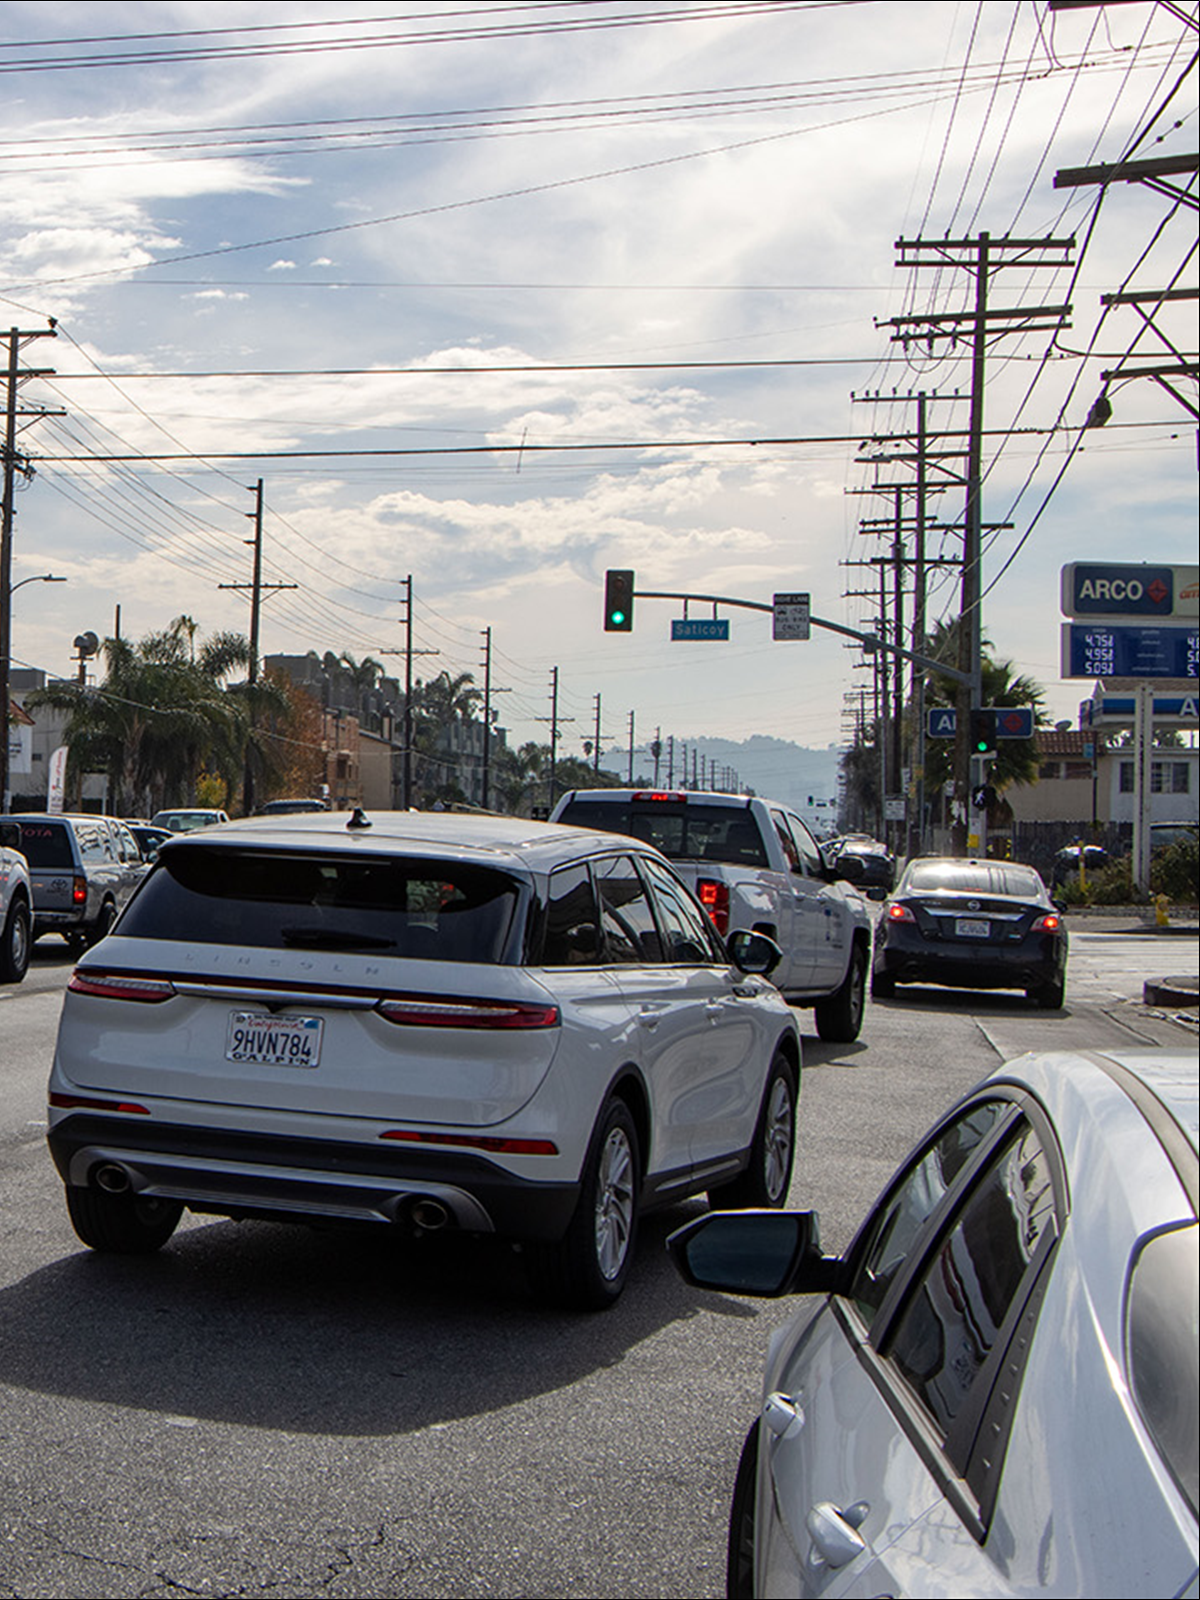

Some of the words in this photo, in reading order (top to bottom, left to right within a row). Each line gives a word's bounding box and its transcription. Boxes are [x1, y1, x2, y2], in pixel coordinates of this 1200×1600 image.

[1078, 579, 1144, 601] ARCO
[674, 623, 726, 637] Saticoy
[21, 828, 53, 838] OTA
[231, 1029, 312, 1058] 9HVN784
